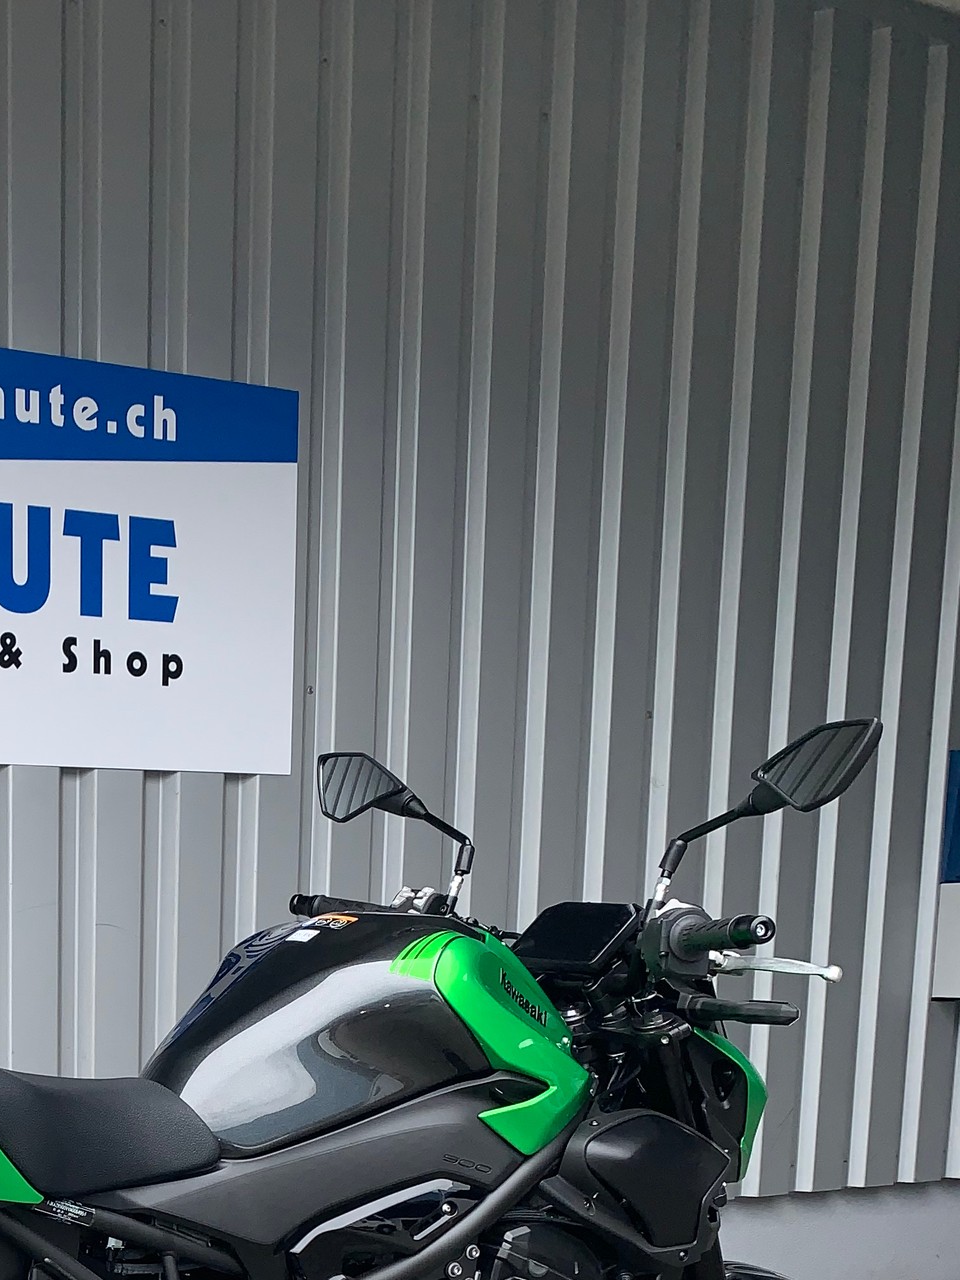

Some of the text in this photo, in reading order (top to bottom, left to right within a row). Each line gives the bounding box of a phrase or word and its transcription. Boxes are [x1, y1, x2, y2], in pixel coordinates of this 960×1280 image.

[62, 636, 184, 687] Shop
[500, 968, 547, 1027] Kawasaki
[442, 1153, 492, 1174] 900
